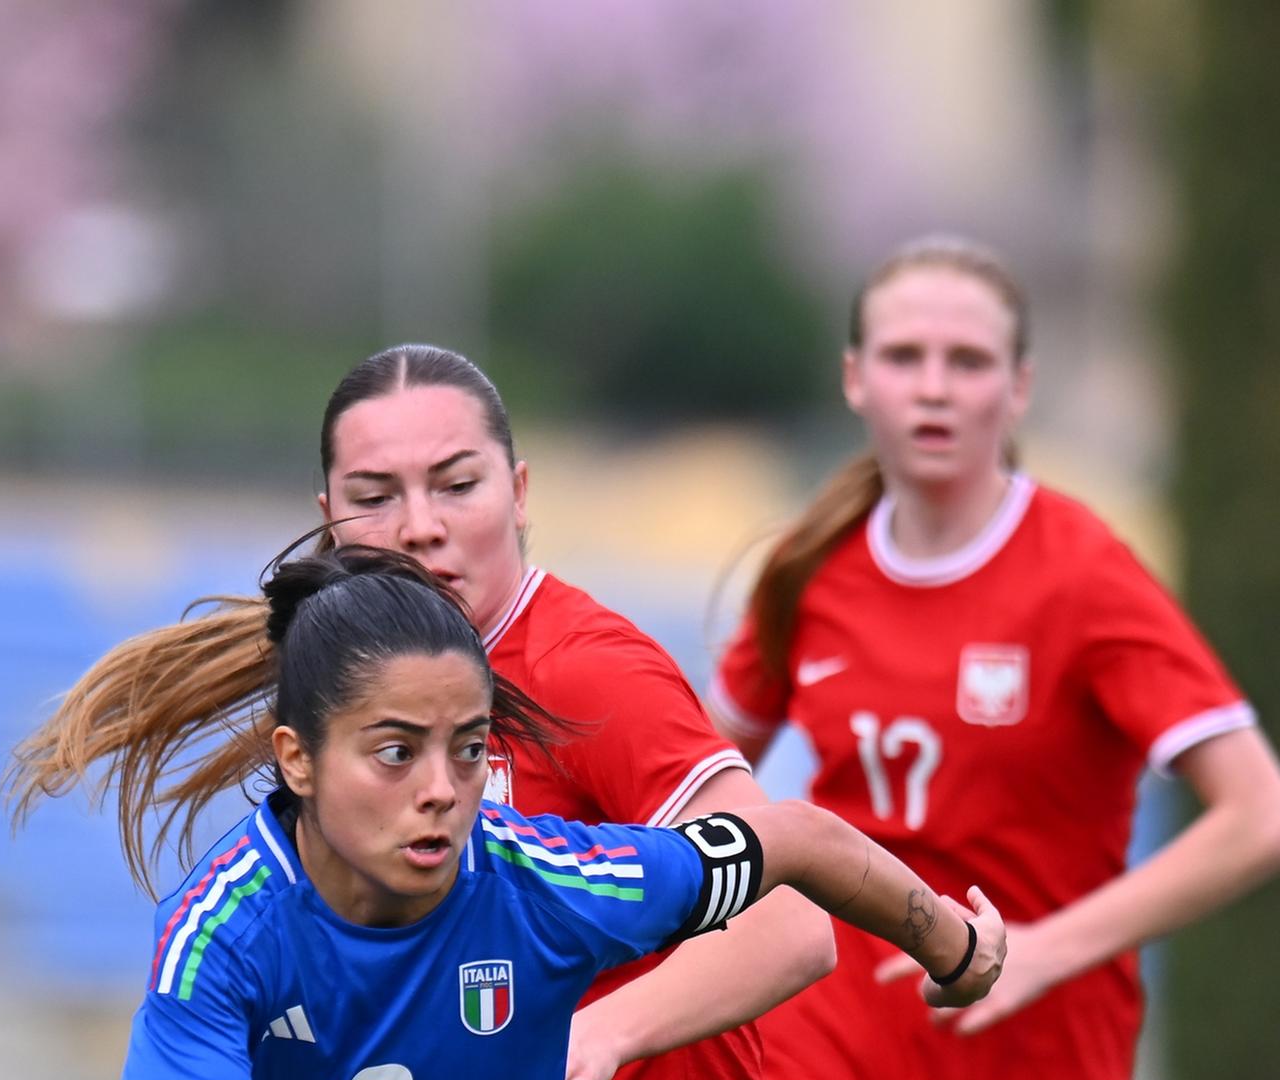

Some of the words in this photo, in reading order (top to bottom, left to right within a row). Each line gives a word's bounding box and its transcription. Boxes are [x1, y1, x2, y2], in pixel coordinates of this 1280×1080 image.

[849, 712, 942, 830] 17
[685, 818, 746, 858] C
[464, 966, 508, 983] ITALIA
